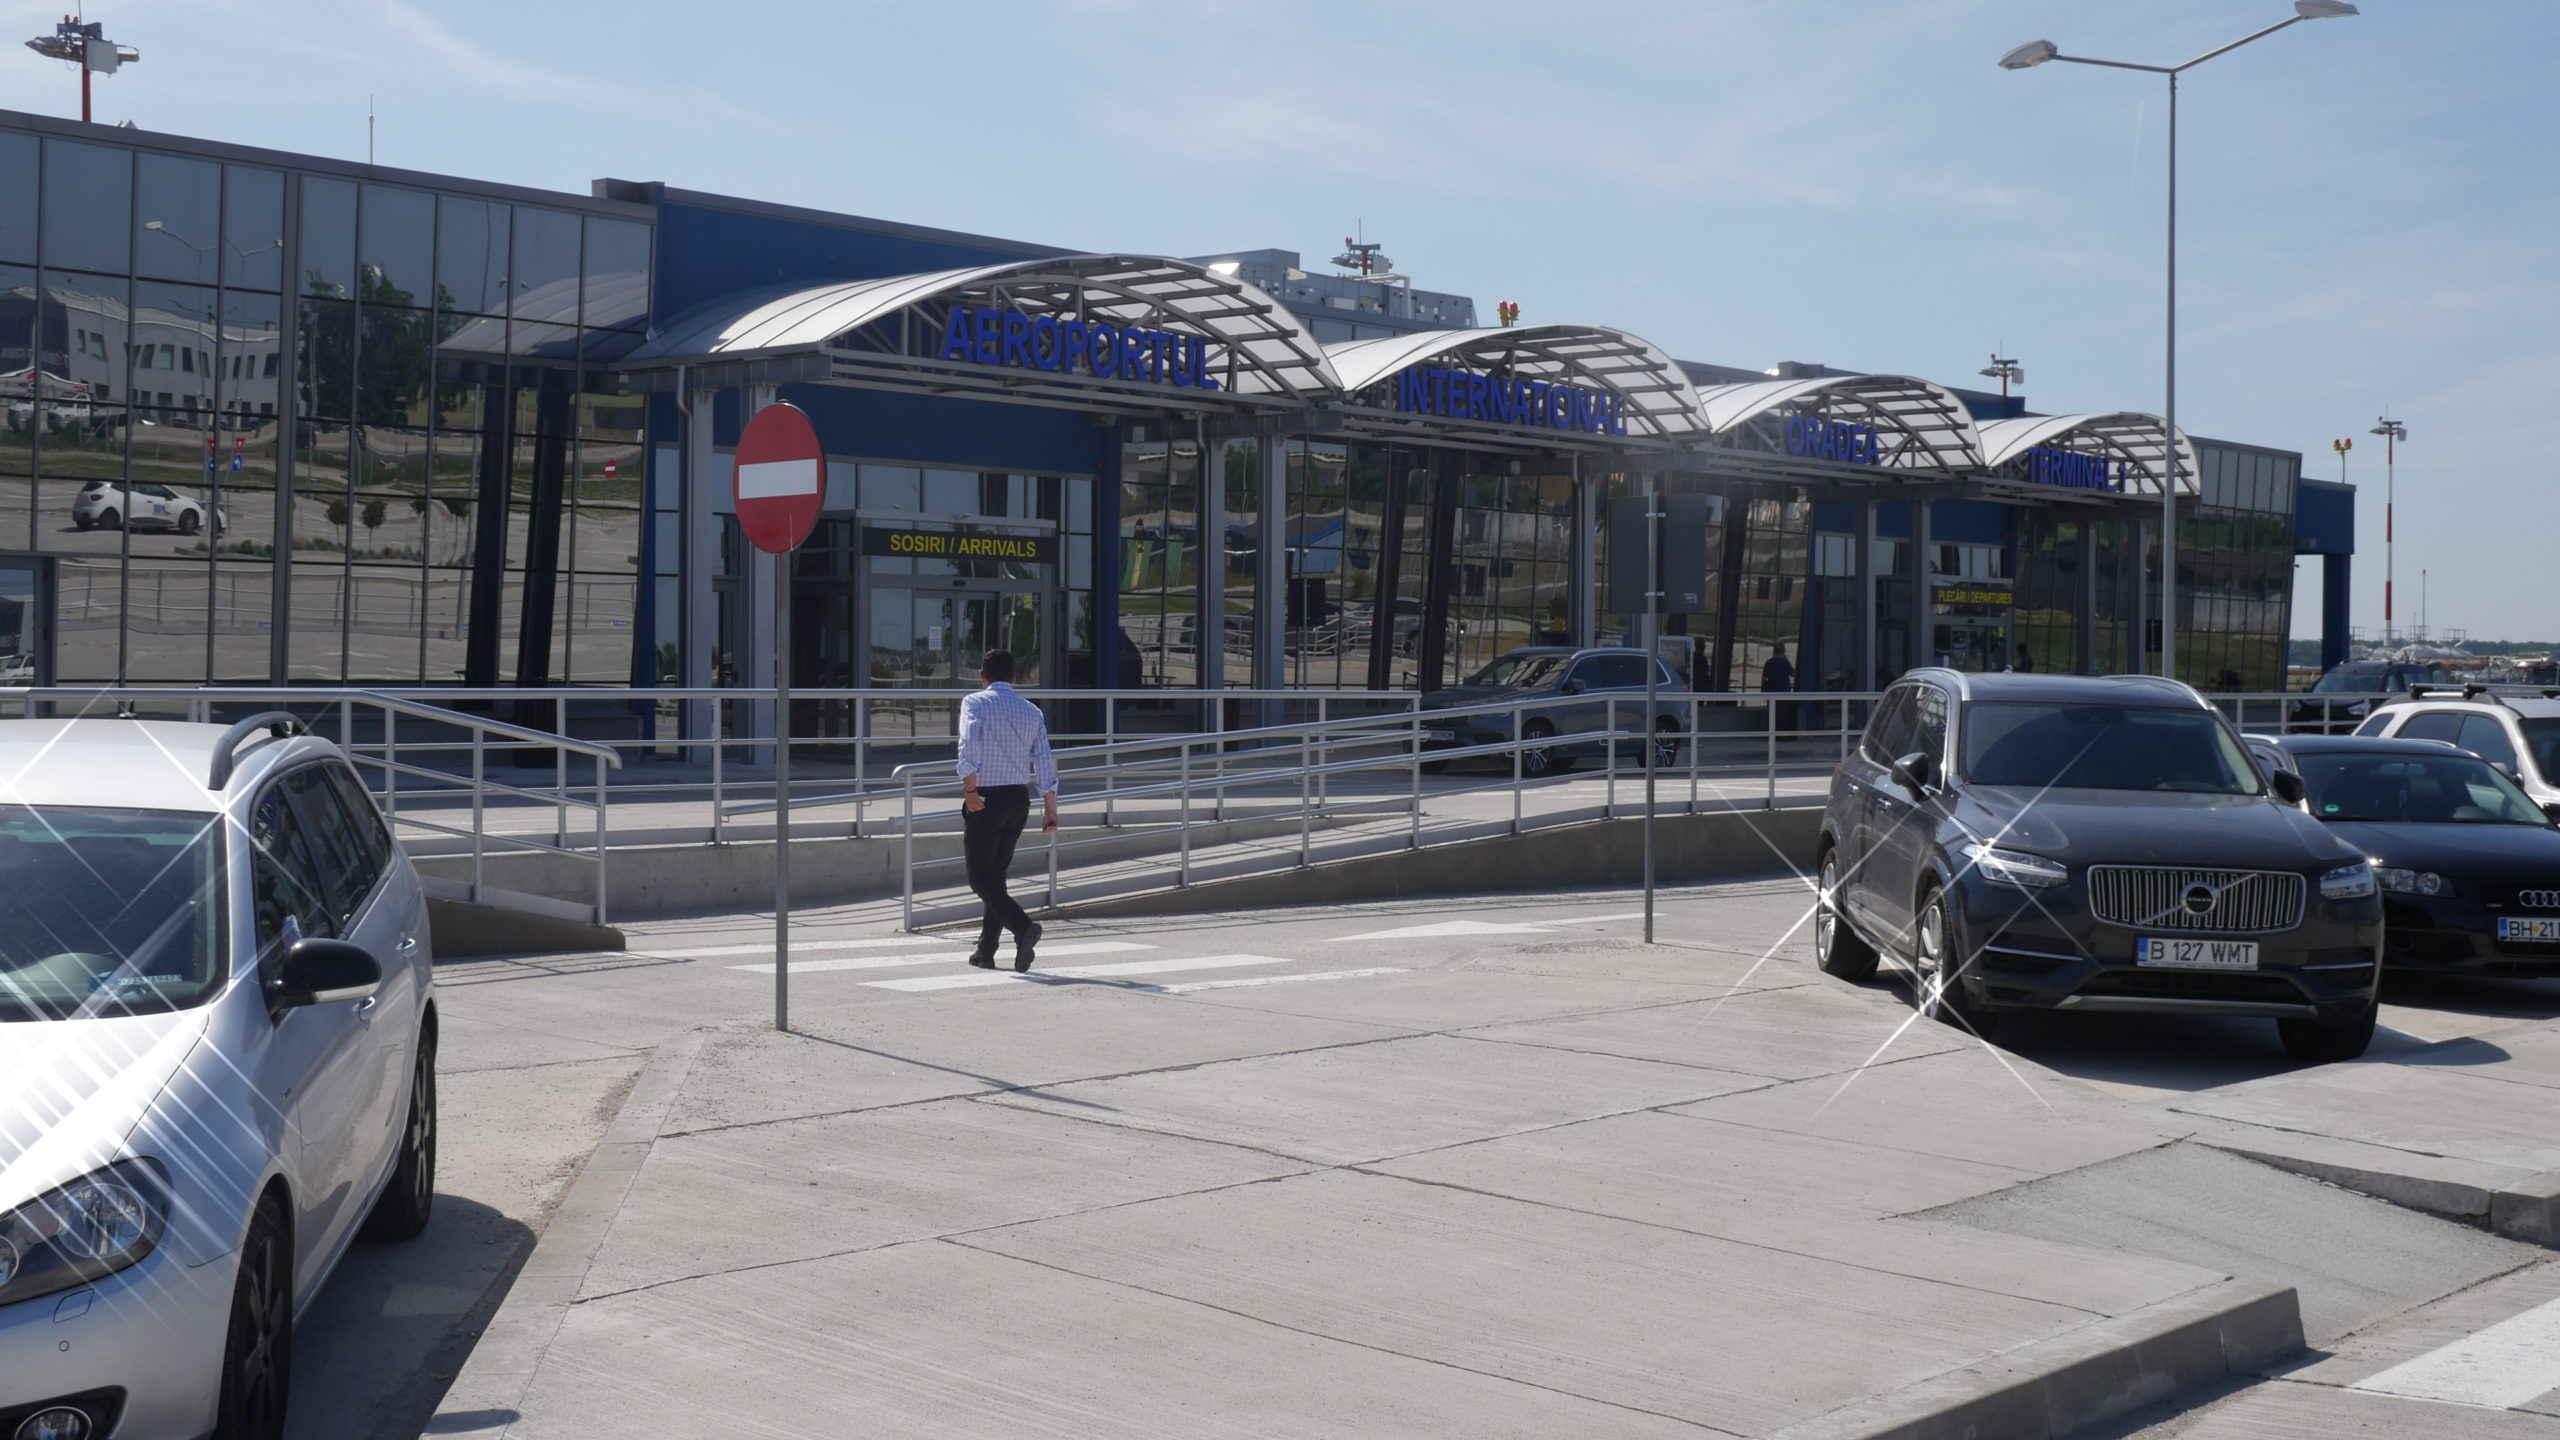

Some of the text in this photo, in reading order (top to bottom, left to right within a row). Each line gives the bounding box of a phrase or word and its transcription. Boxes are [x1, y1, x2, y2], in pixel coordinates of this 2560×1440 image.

[943, 305, 1219, 389] AEROPORTUL
[1400, 366, 1628, 436] INTERNATIONAL
[1787, 415, 1880, 465] ORADEA
[2027, 447, 2116, 492] TERMINAL
[890, 534, 1036, 558] SOSIRI / ARRIVALS
[1971, 591, 2013, 605] DEPARTURES
[2509, 921, 2533, 937] BH
[2539, 921, 2554, 937] 21
[2150, 940, 2253, 964] B 127 WMT
